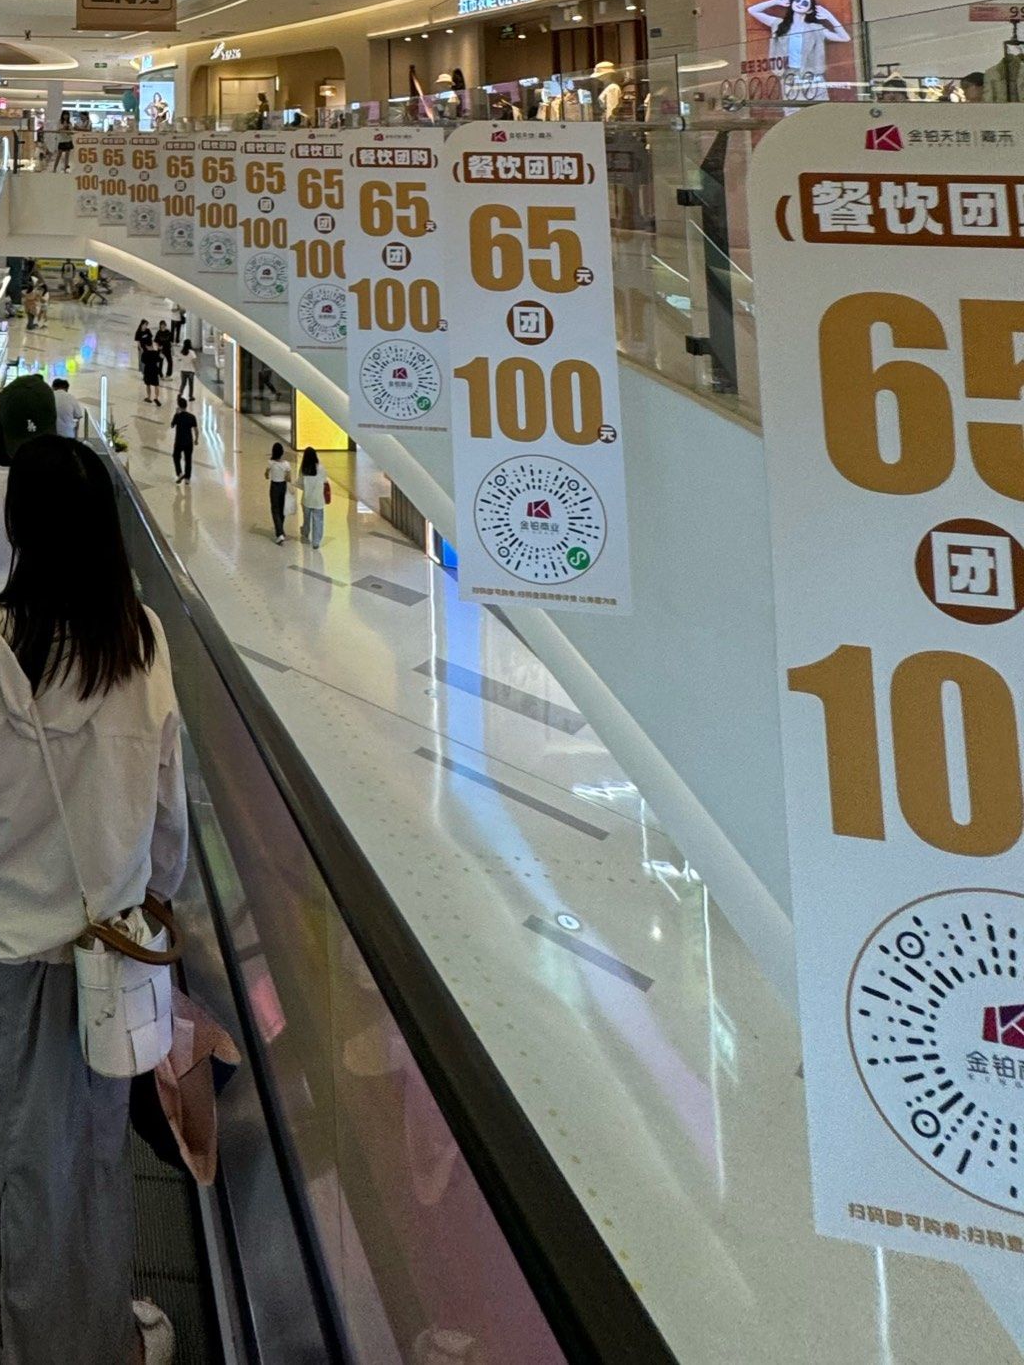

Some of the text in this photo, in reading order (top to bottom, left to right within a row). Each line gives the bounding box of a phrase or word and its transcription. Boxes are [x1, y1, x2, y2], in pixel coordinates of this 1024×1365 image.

[78, 148, 97, 164] 65
[103, 149, 125, 166] 65
[132, 149, 157, 170] 65
[297, 144, 343, 158] 餐饮团
[359, 150, 429, 166] 餐饮团购
[166, 155, 194, 178] 65
[202, 156, 235, 184] 65
[245, 161, 285, 194] 65
[468, 155, 579, 180] 餐饮团购
[75, 175, 98, 190] 100
[99, 179, 127, 195] 100
[128, 184, 159, 202] 100
[298, 168, 343, 209] 65
[162, 195, 195, 216] 100
[196, 203, 237, 229] 100
[360, 180, 430, 237] 65
[812, 181, 1024, 237] 餐饮团
[239, 217, 288, 249] 100
[470, 204, 582, 294] 65
[349, 278, 440, 333] 100
[513, 307, 546, 338] 团
[454, 357, 604, 446] 100
[931, 531, 1016, 610] 团
